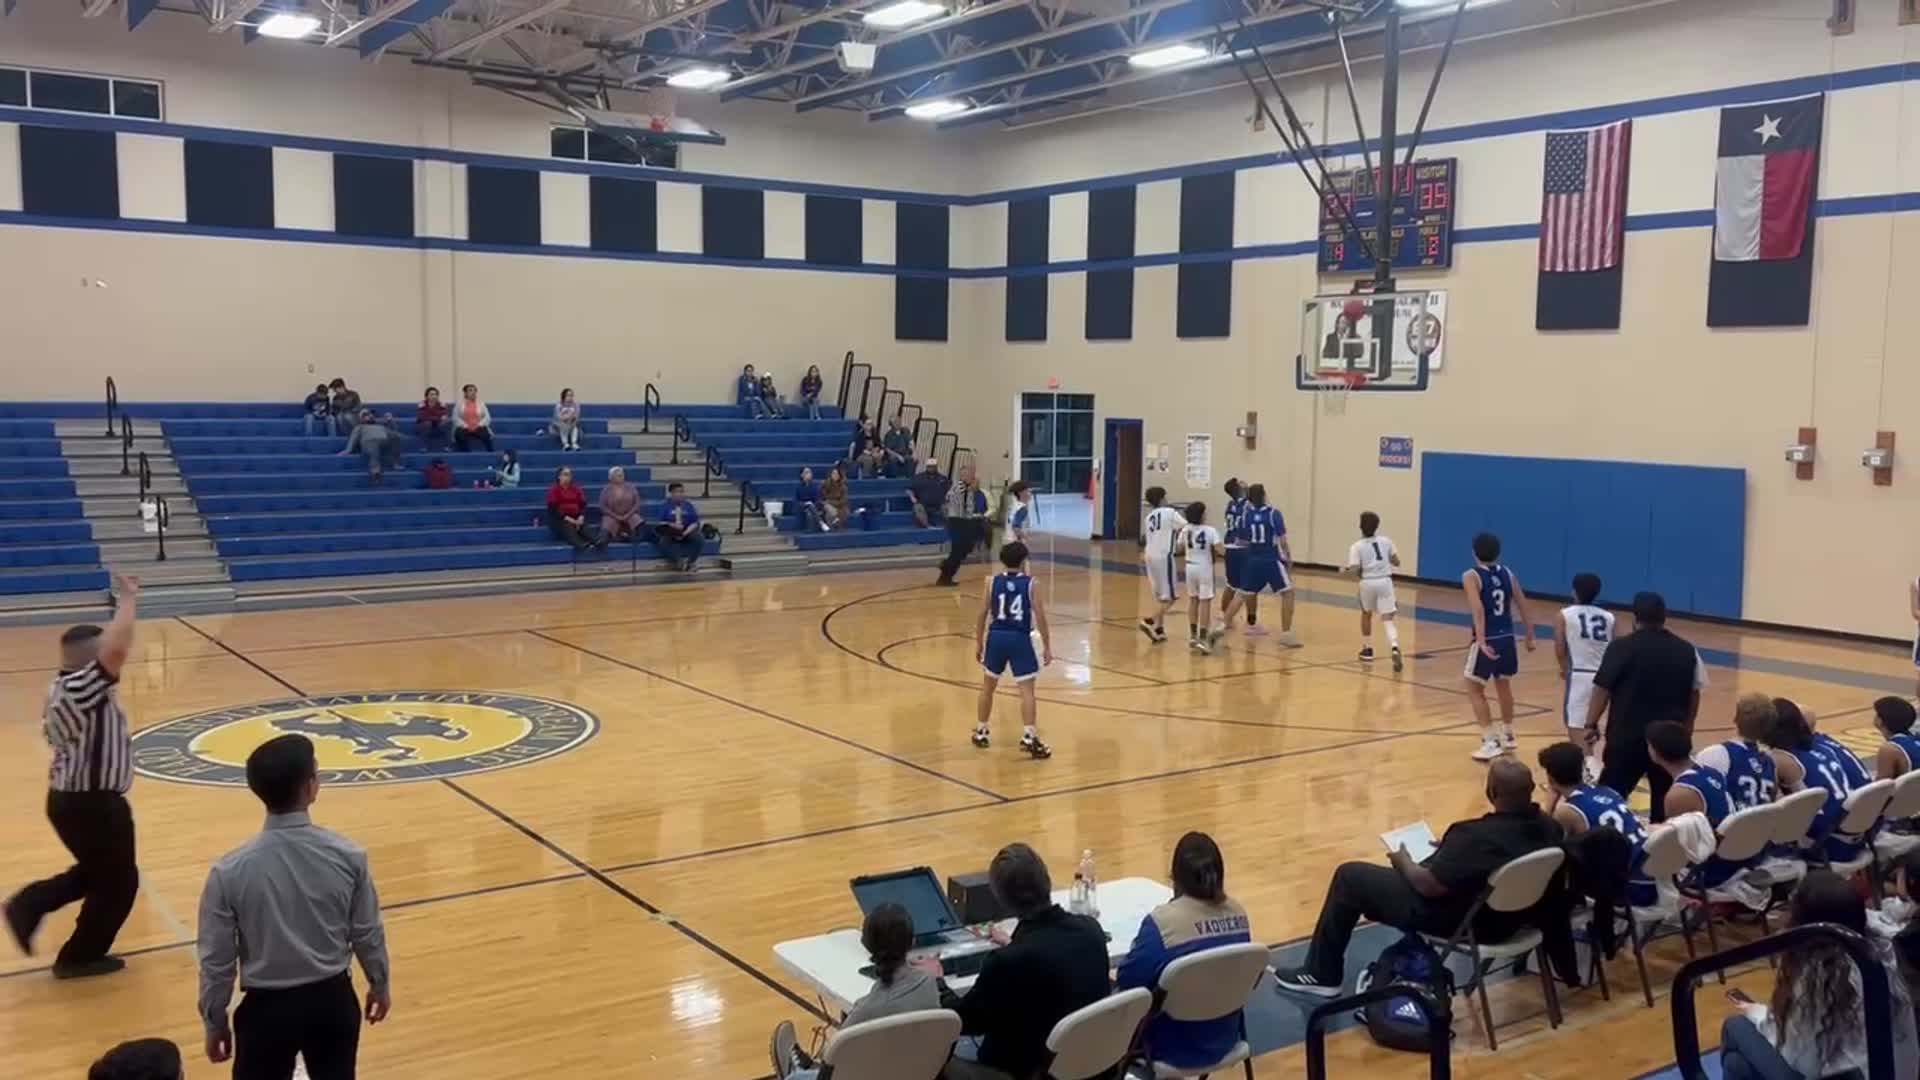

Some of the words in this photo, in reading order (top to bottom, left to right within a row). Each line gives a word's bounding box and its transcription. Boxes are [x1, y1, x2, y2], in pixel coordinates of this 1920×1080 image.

[1420, 182, 1449, 210] 35
[1148, 512, 1161, 532] 31
[1250, 523, 1266, 543] 11
[1187, 530, 1206, 550] 14
[1371, 542, 1383, 561] 1
[997, 593, 1024, 621] 14
[1492, 589, 1504, 616] 3
[1578, 613, 1608, 641] 12
[1738, 775, 1775, 808] 35
